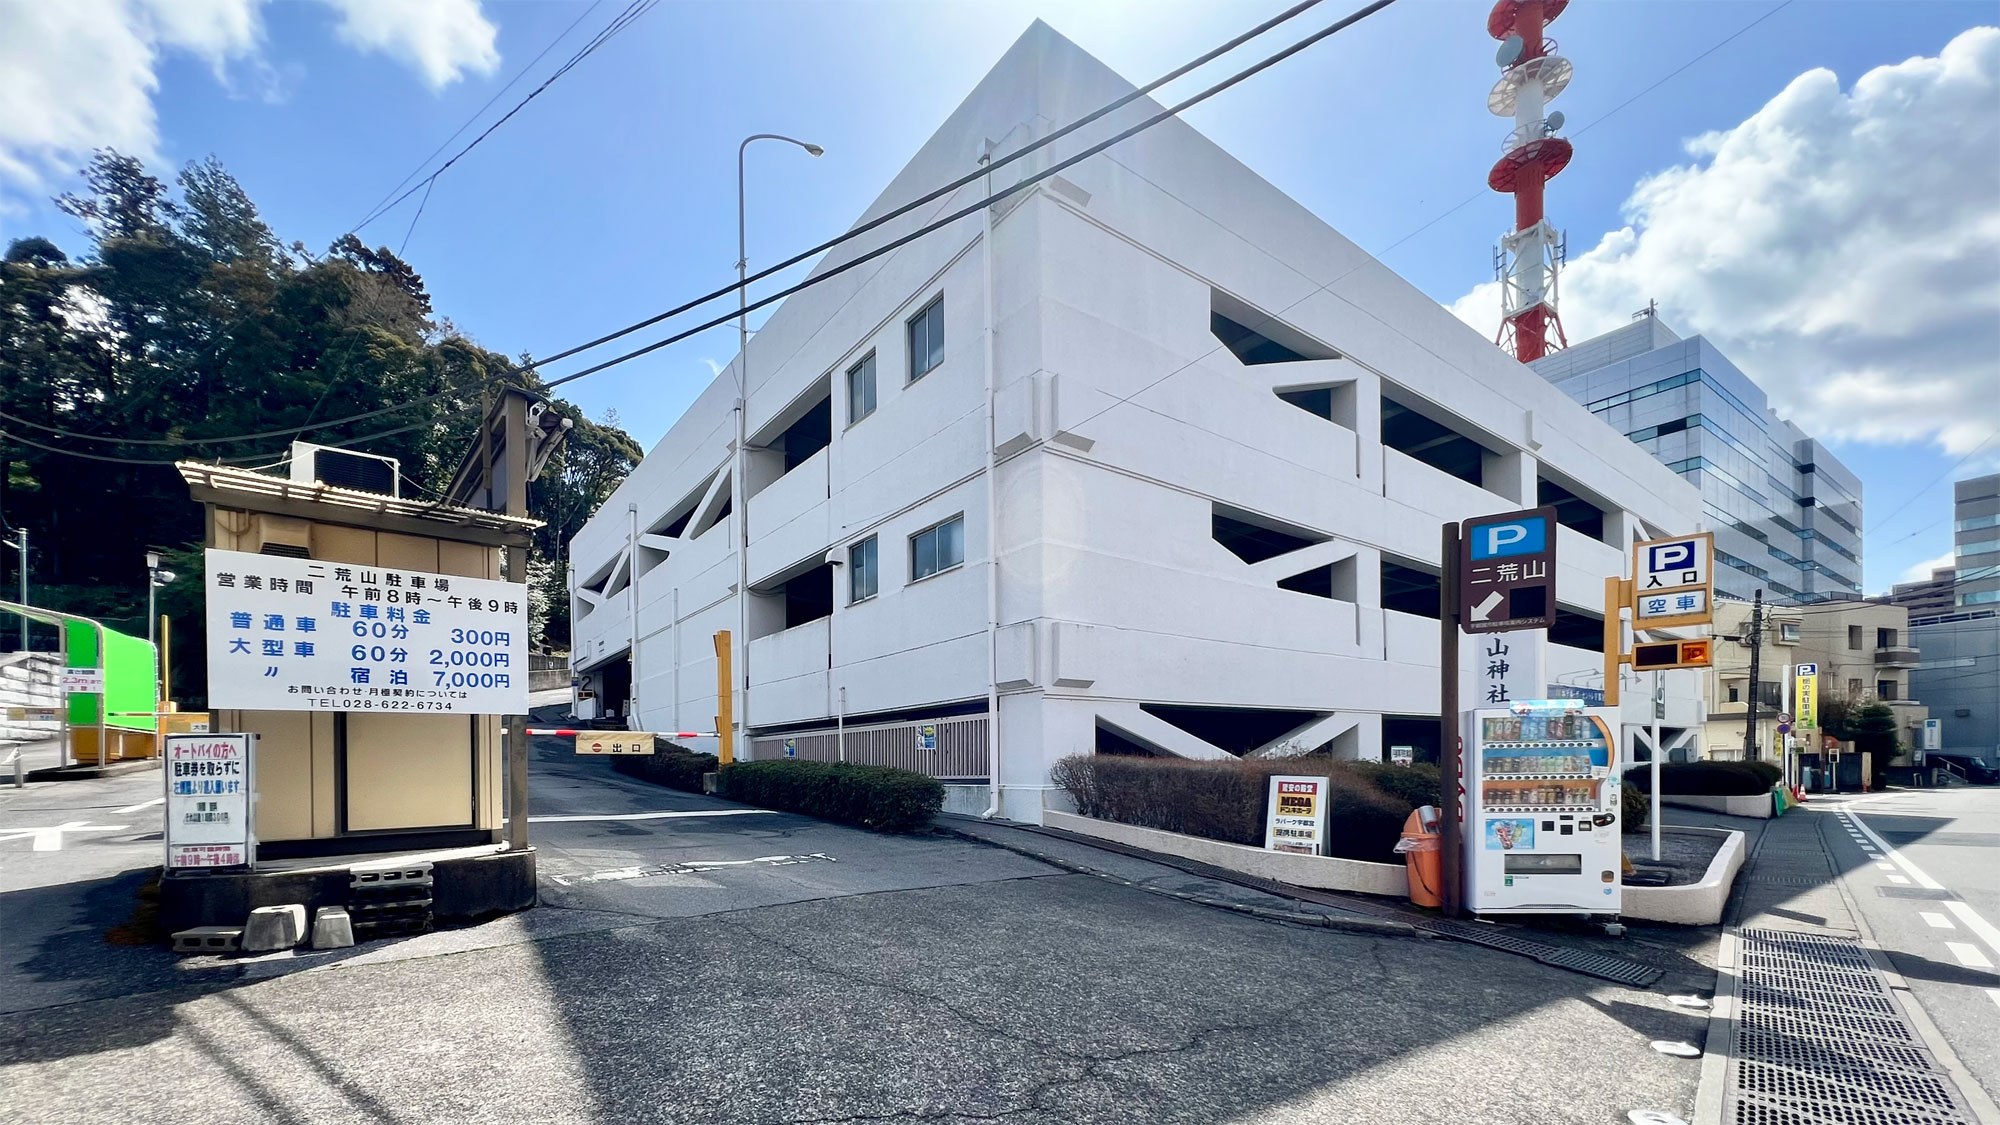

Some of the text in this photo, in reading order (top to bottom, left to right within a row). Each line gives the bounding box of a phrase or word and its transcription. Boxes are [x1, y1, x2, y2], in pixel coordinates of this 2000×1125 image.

[1488, 524, 1527, 555] P
[1655, 545, 1689, 571] P
[307, 564, 450, 593] 二荒山駐車場
[1470, 560, 1546, 584] 二荒山
[1646, 570, 1698, 588] 入口
[216, 572, 314, 595] 営業時間
[330, 601, 431, 625] 駐車料金
[1647, 595, 1697, 614] 空車
[229, 611, 510, 647] 普通車 60分 300円
[229, 637, 510, 668] 大型車 60分 2,000円
[350, 667, 408, 686] 宿泊
[432, 671, 510, 689] 7,000円
[1486, 630, 1511, 704] 山神社
[581, 675, 593, 692] 2
[307, 698, 453, 710] TEL028-622-6734
[173, 742, 237, 760] オートバイの方へ
[612, 743, 641, 753] 出口
[173, 761, 240, 777] 駐車券を取らずに
[1280, 796, 1312, 807] MEGA
